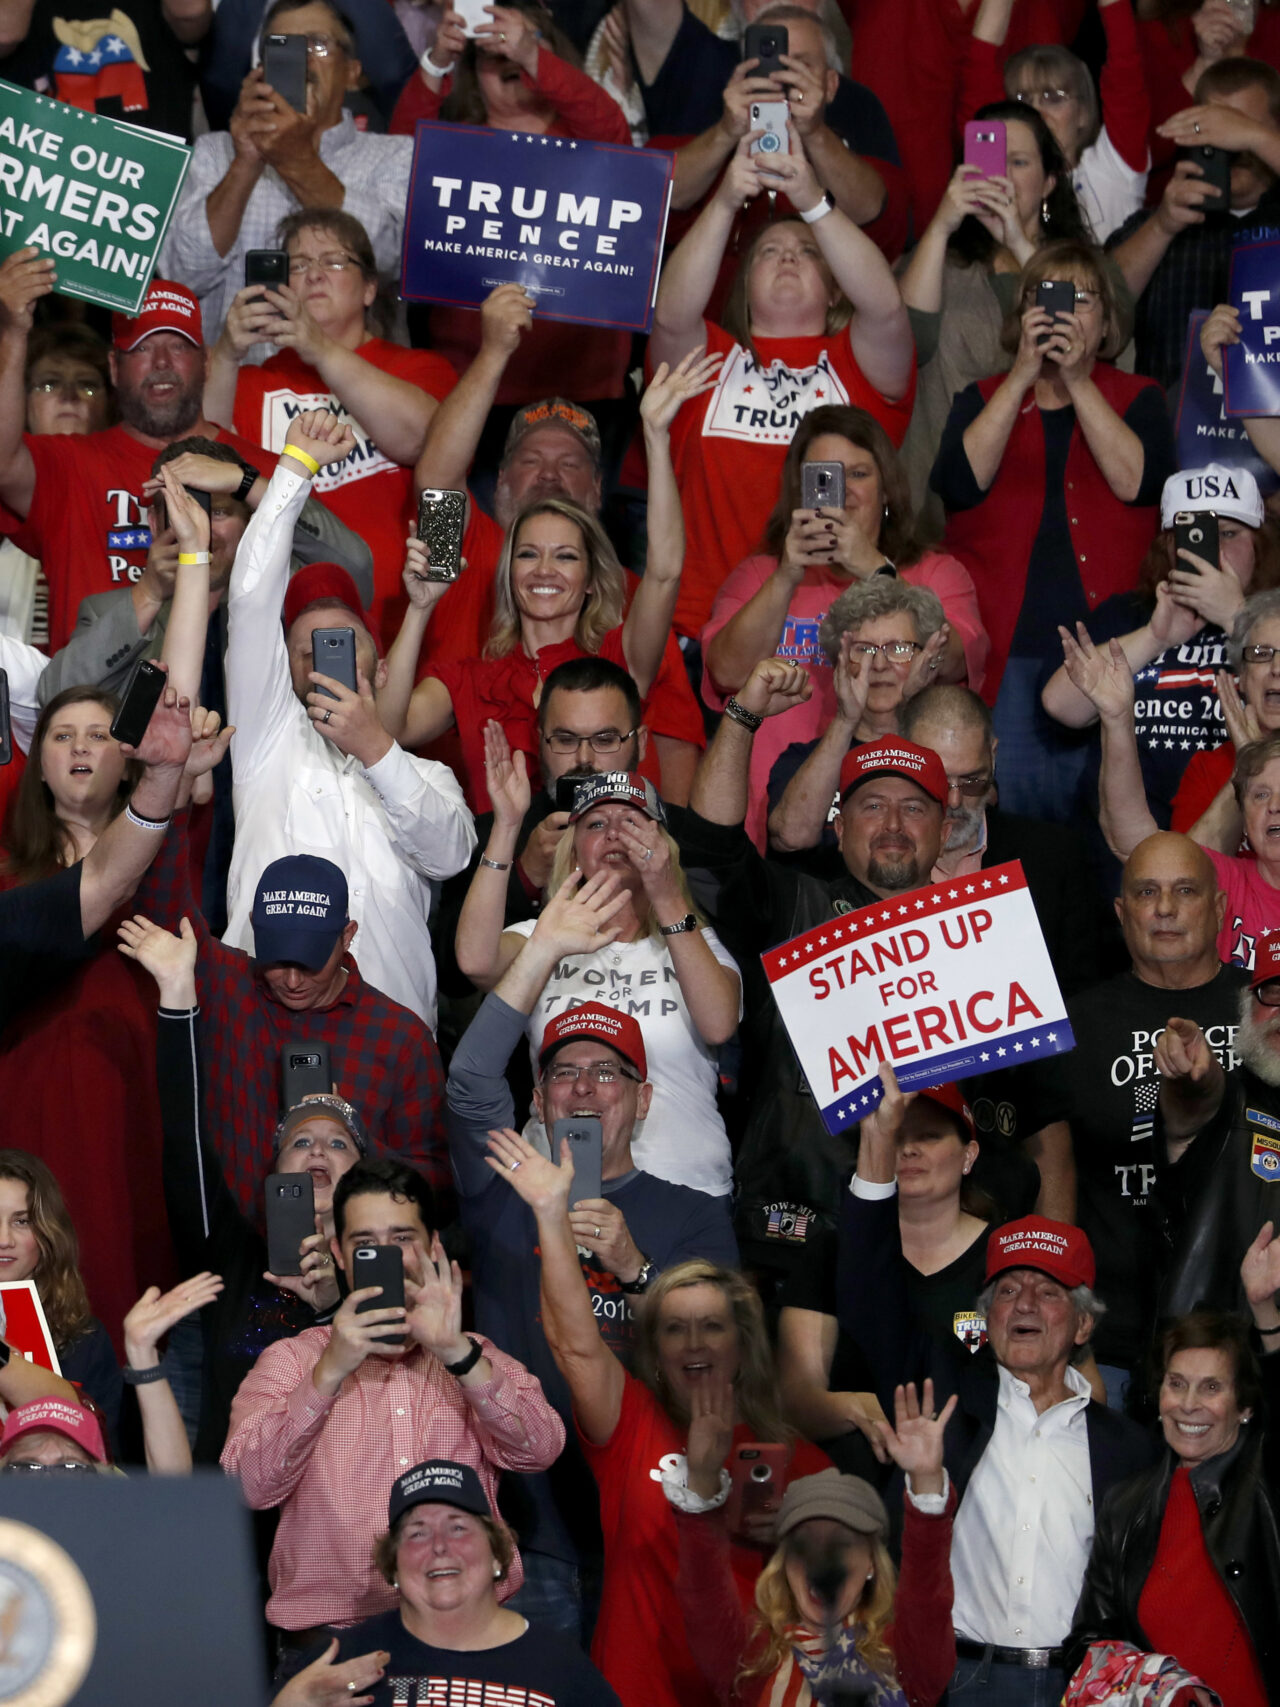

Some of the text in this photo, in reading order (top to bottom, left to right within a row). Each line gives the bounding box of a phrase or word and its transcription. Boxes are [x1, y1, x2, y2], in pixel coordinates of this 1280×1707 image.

[70, 144, 145, 189] OUR
[431, 176, 642, 231] TRUMP
[445, 215, 618, 256] PENCE
[25, 223, 151, 281] AGAIN!
[424, 239, 635, 277] MAKE AMERICA GREAT AGAIN!
[150, 291, 195, 310] AMERICA
[140, 302, 192, 318] EAT AGAIN
[732, 404, 801, 430] TRUM
[1197, 424, 1236, 439] MAKE
[1185, 475, 1241, 501] USA
[1134, 695, 1227, 721] ence 20
[1134, 724, 1209, 736] EP AMERICA
[856, 749, 926, 764] MAKE AMERICA
[861, 758, 922, 771] GREAT AGAIN
[606, 773, 627, 783] NO
[588, 784, 646, 800] APOLOGIES
[263, 891, 331, 905] MAKE AMERICA
[265, 903, 328, 918] GREAT AGAIN
[808, 908, 993, 1000] STAND UP
[555, 963, 676, 988] WOMEN
[595, 987, 632, 1001] FOR
[878, 969, 939, 1007] FOR
[544, 996, 679, 1017] TRMP
[556, 1013, 622, 1030] MAKE AMERICA
[559, 1022, 618, 1036] GREAT AGAIN
[826, 981, 1044, 1093] AMERICA
[1257, 1136, 1280, 1150] MISSOU
[762, 1201, 817, 1223] POW MIA
[999, 1231, 1068, 1247] MAKE AMERICA
[1003, 1241, 1063, 1255] GREAT AGAIN
[956, 1320, 987, 1332] TRUM
[17, 1403, 84, 1421] MAKE AMERICA
[19, 1410, 80, 1427] GREAT AGAIN
[401, 1467, 463, 1488] MAKE AMERICA
[404, 1476, 461, 1495] GREAT AGAIN
